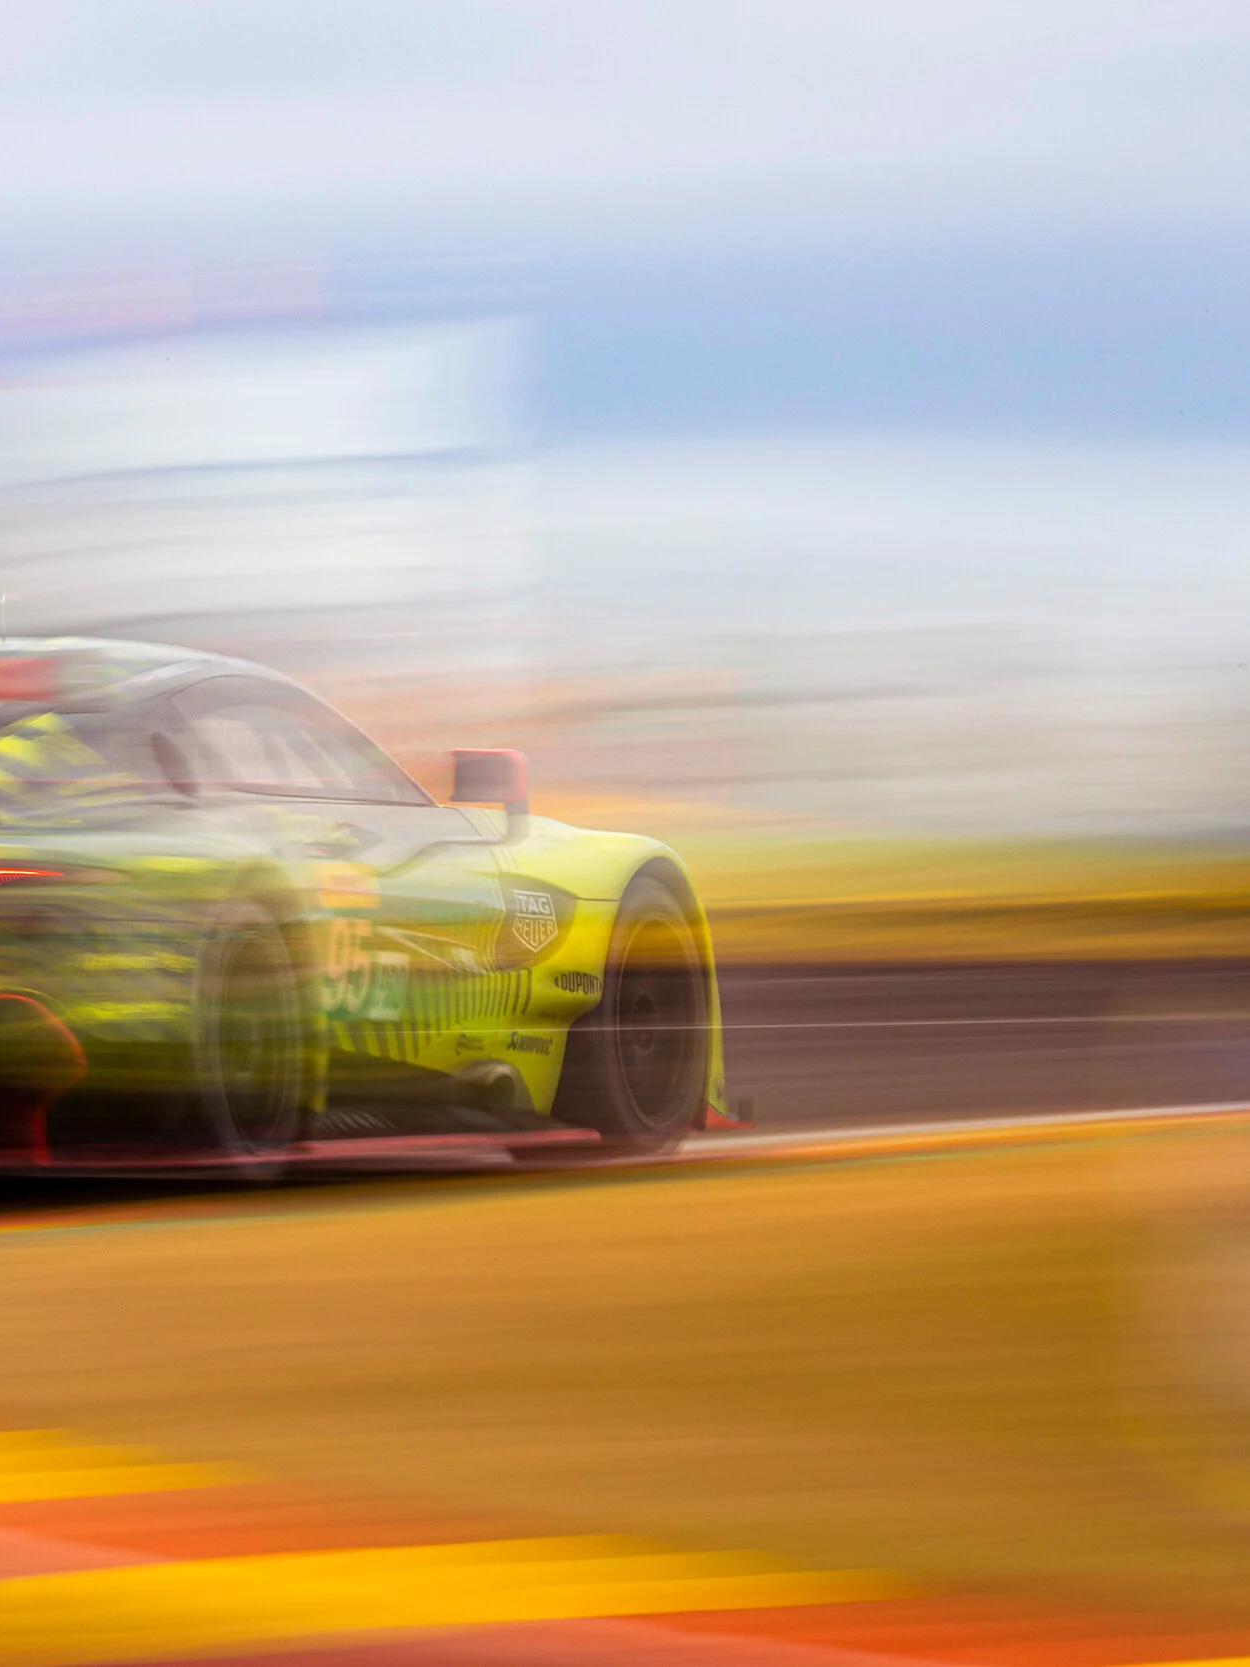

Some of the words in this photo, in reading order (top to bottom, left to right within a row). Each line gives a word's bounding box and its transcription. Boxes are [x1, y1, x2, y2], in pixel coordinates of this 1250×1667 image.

[519, 895, 549, 915] TAG
[514, 918, 553, 947] HEUER
[561, 971, 600, 995] DUPONT
